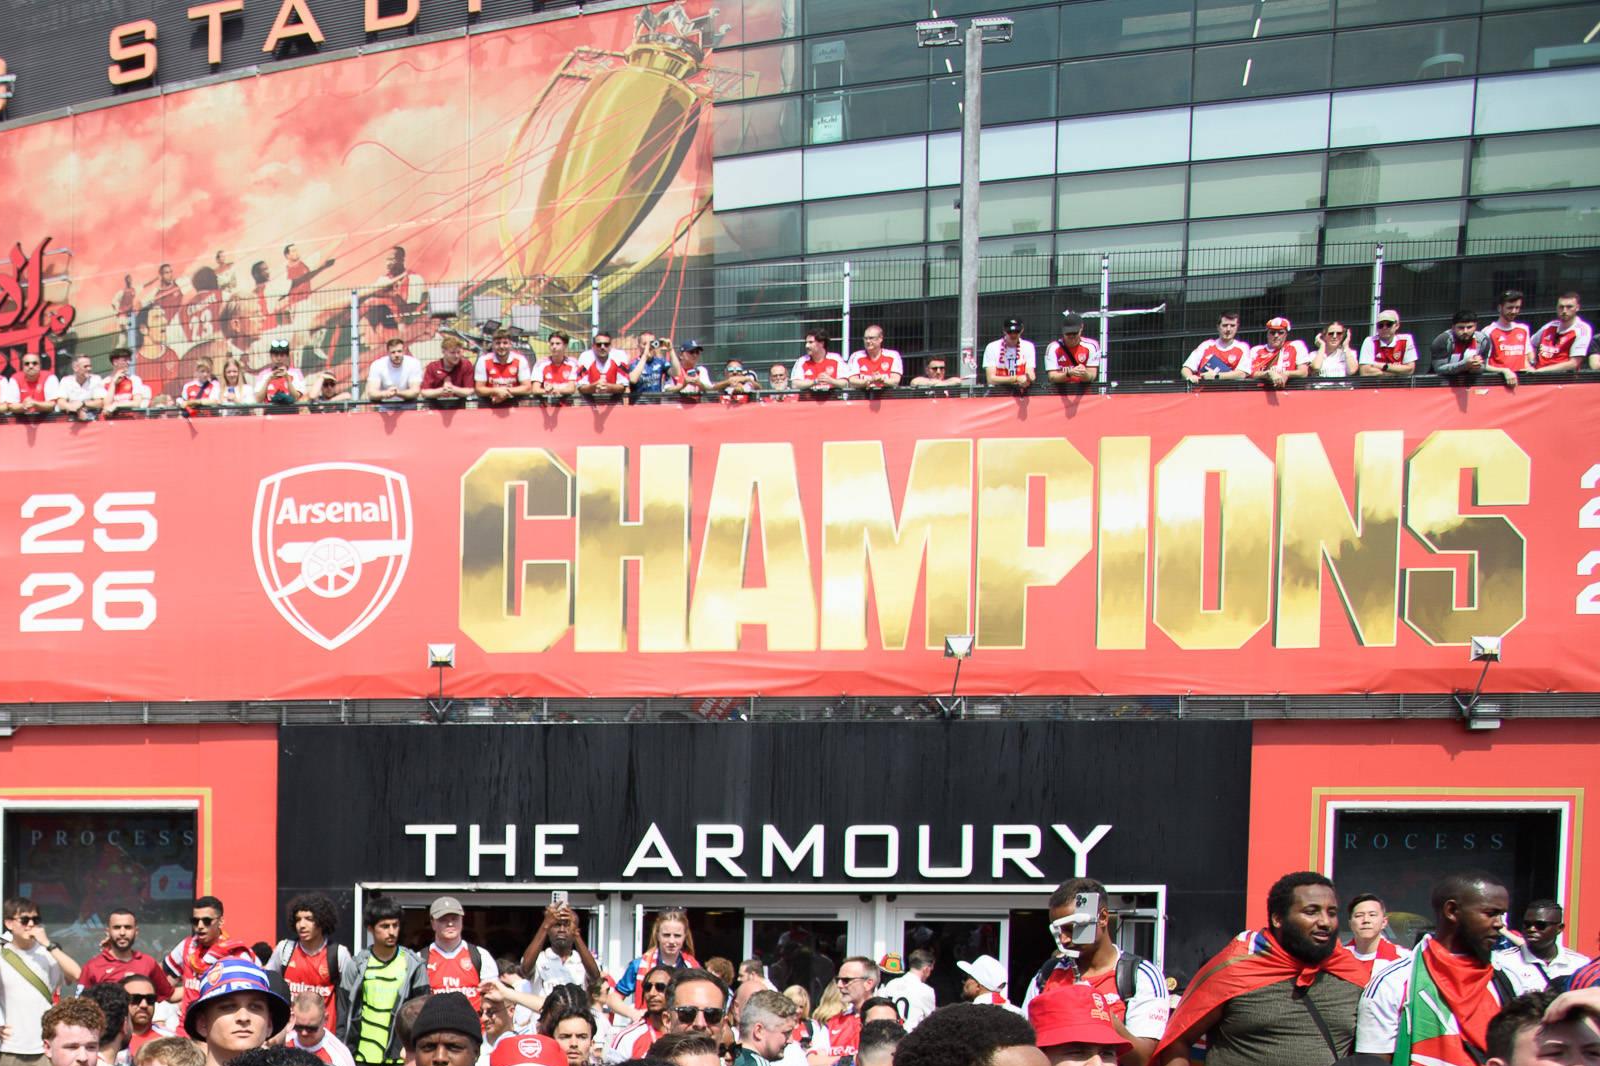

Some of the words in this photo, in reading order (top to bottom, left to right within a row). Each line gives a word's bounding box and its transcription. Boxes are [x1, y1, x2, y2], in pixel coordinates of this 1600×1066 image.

[108, 0, 481, 85] STAD
[19, 491, 158, 554] 25
[276, 495, 389, 524] Arsenal
[459, 430, 1531, 654] CHAMPIONS
[19, 570, 158, 632] 26
[31, 829, 194, 846] PROCESS
[405, 824, 580, 877] THE
[622, 822, 1113, 879] ARMOURY
[1344, 832, 1504, 851] ROCESS
